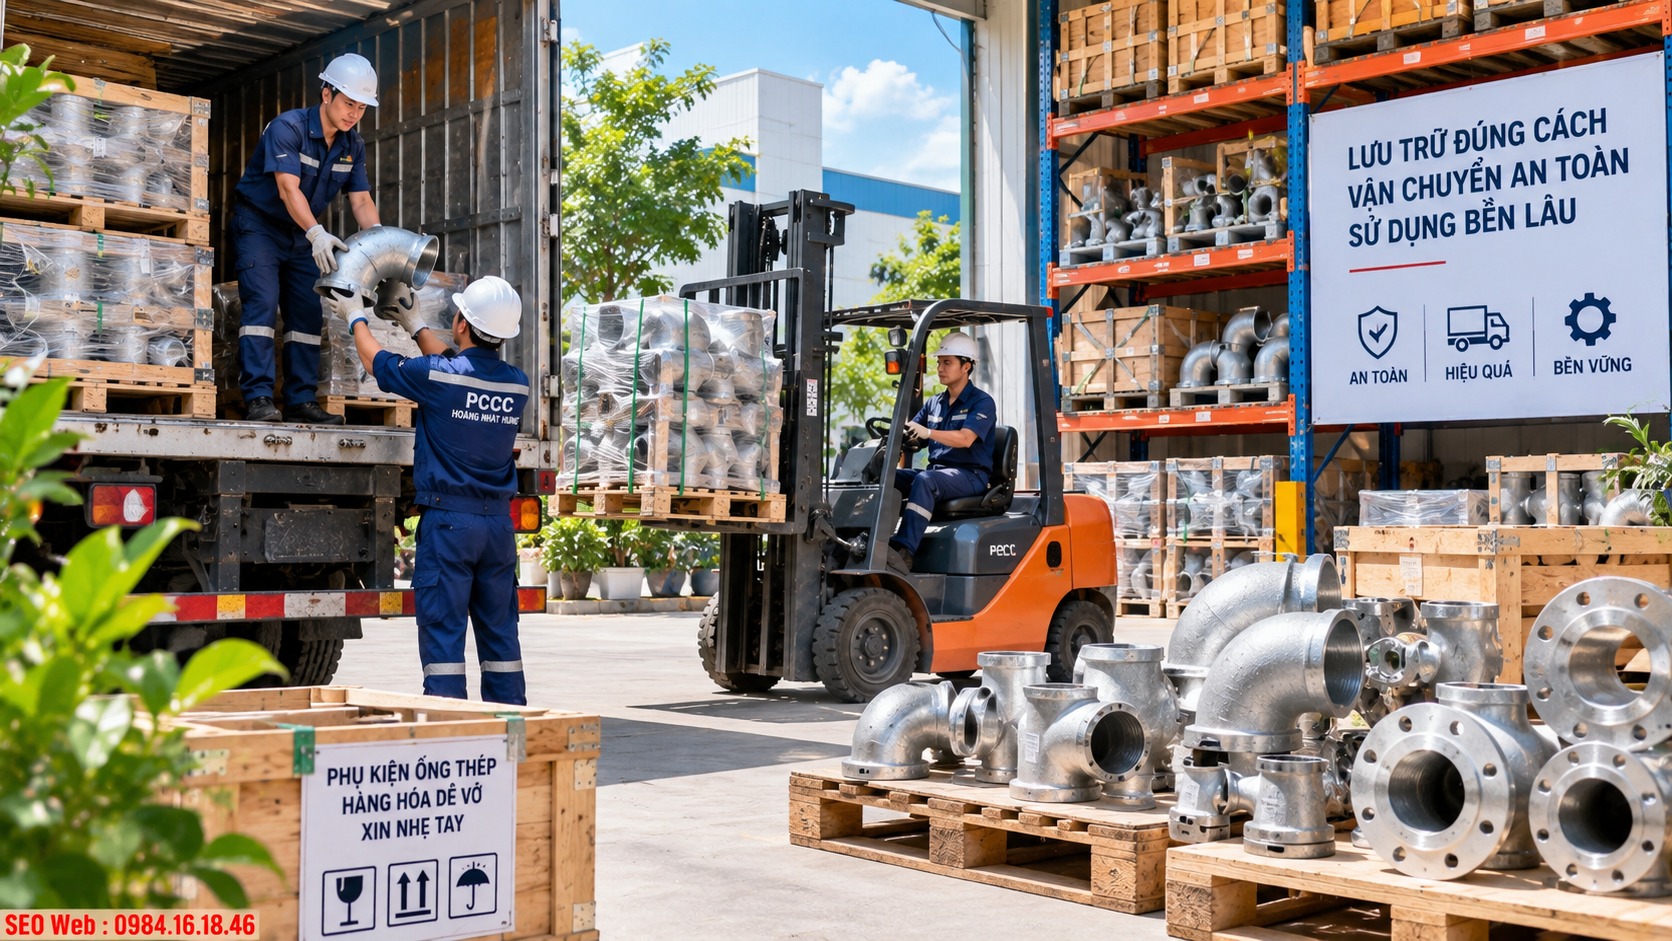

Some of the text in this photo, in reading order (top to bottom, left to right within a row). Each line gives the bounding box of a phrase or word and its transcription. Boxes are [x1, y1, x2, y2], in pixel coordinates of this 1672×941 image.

[1348, 107, 1607, 170] LƯU TRỮ ĐÚNG CÁCH
[1348, 145, 1629, 212] VẬN CHUYỂN AN TOÀN
[1348, 194, 1577, 248] SỬ DỤNG BỀN LÂU
[1349, 366, 1408, 385] AN TOÀN
[1445, 360, 1513, 383] HIỆU QUÁ
[1588, 355, 1632, 373] VỮNG
[465, 392, 514, 413] PCCC
[327, 754, 497, 789] PHỤ KIỆN ỐNG THÉP
[342, 791, 391, 815] HÀNG
[397, 787, 431, 811] HÓA
[361, 814, 465, 841] XIN NHẸ TAY
